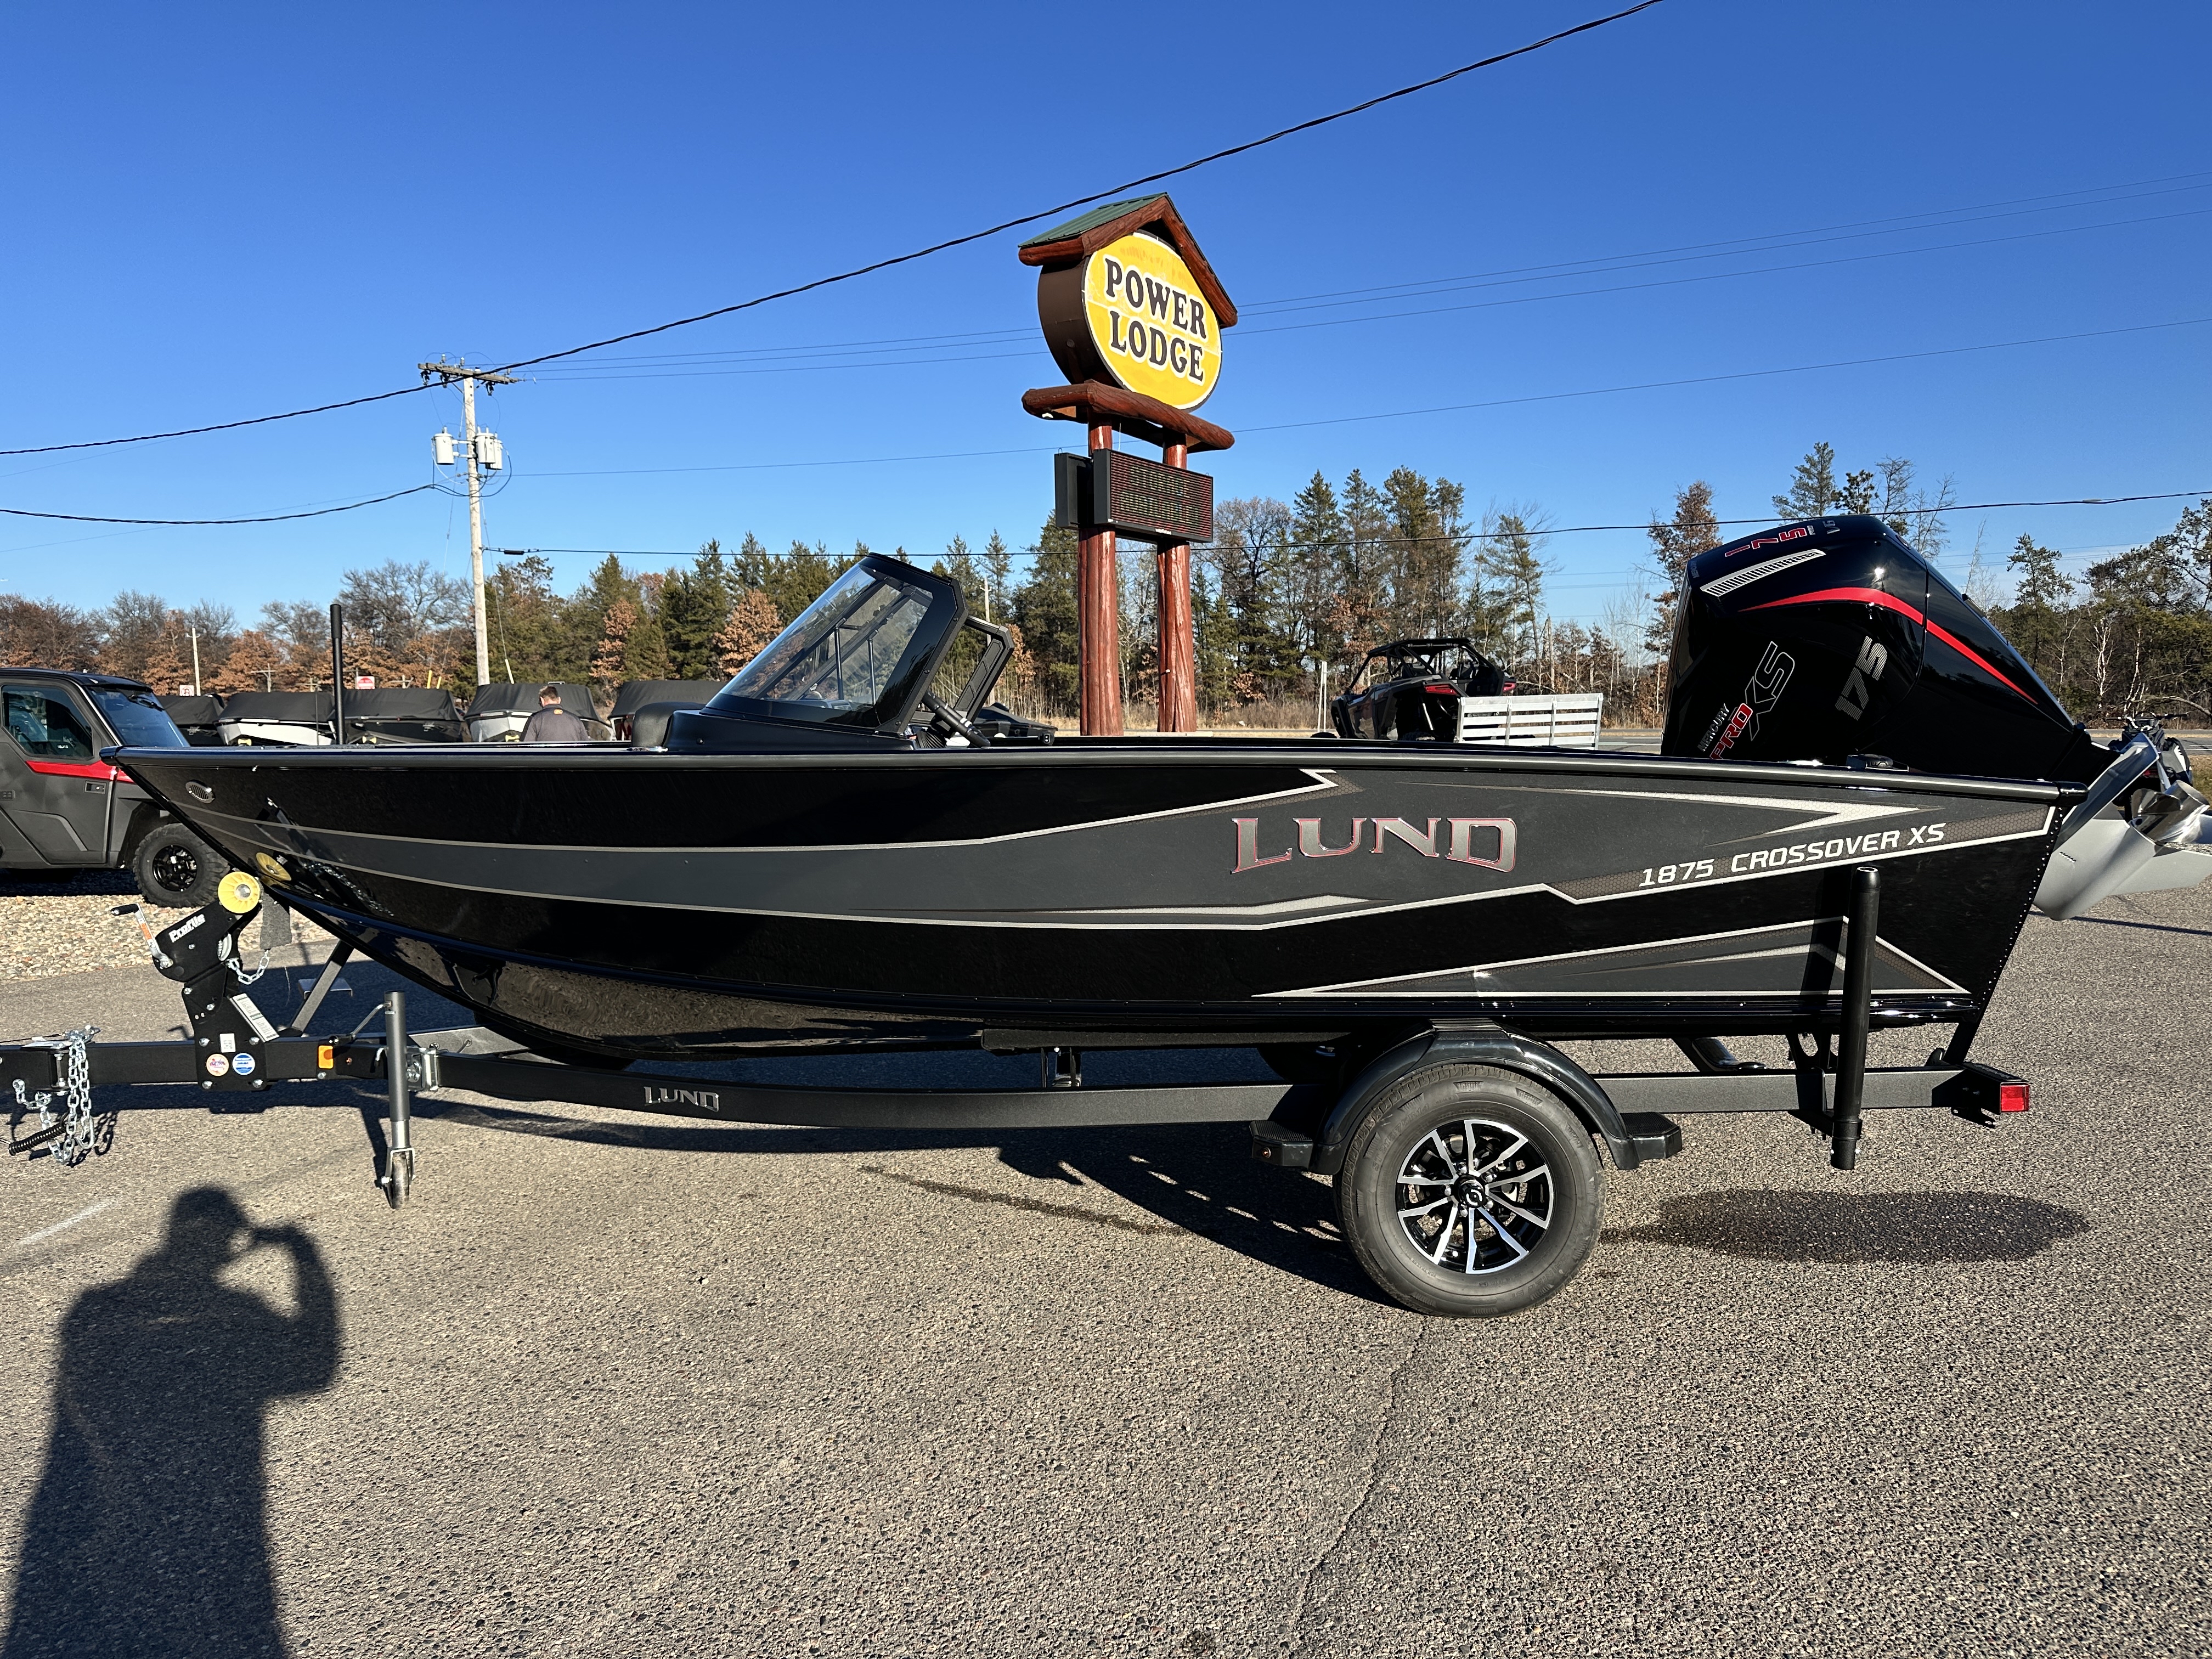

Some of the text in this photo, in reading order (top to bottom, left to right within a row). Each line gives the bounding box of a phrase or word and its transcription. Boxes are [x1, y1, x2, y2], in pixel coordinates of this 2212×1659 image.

[1105, 258, 1206, 338] POWER
[1110, 311, 1204, 382] LODGE
[1130, 465, 1190, 499] STORAGE
[1725, 527, 1807, 557] 175
[1709, 641, 1795, 759] PRO XS
[1835, 635, 1888, 721] 175
[1697, 703, 1730, 752] MERCURY
[1230, 818, 1517, 874] LUND
[1638, 823, 1946, 887] 1875 CROSSOVER XS
[644, 1086, 719, 1112] LUND
